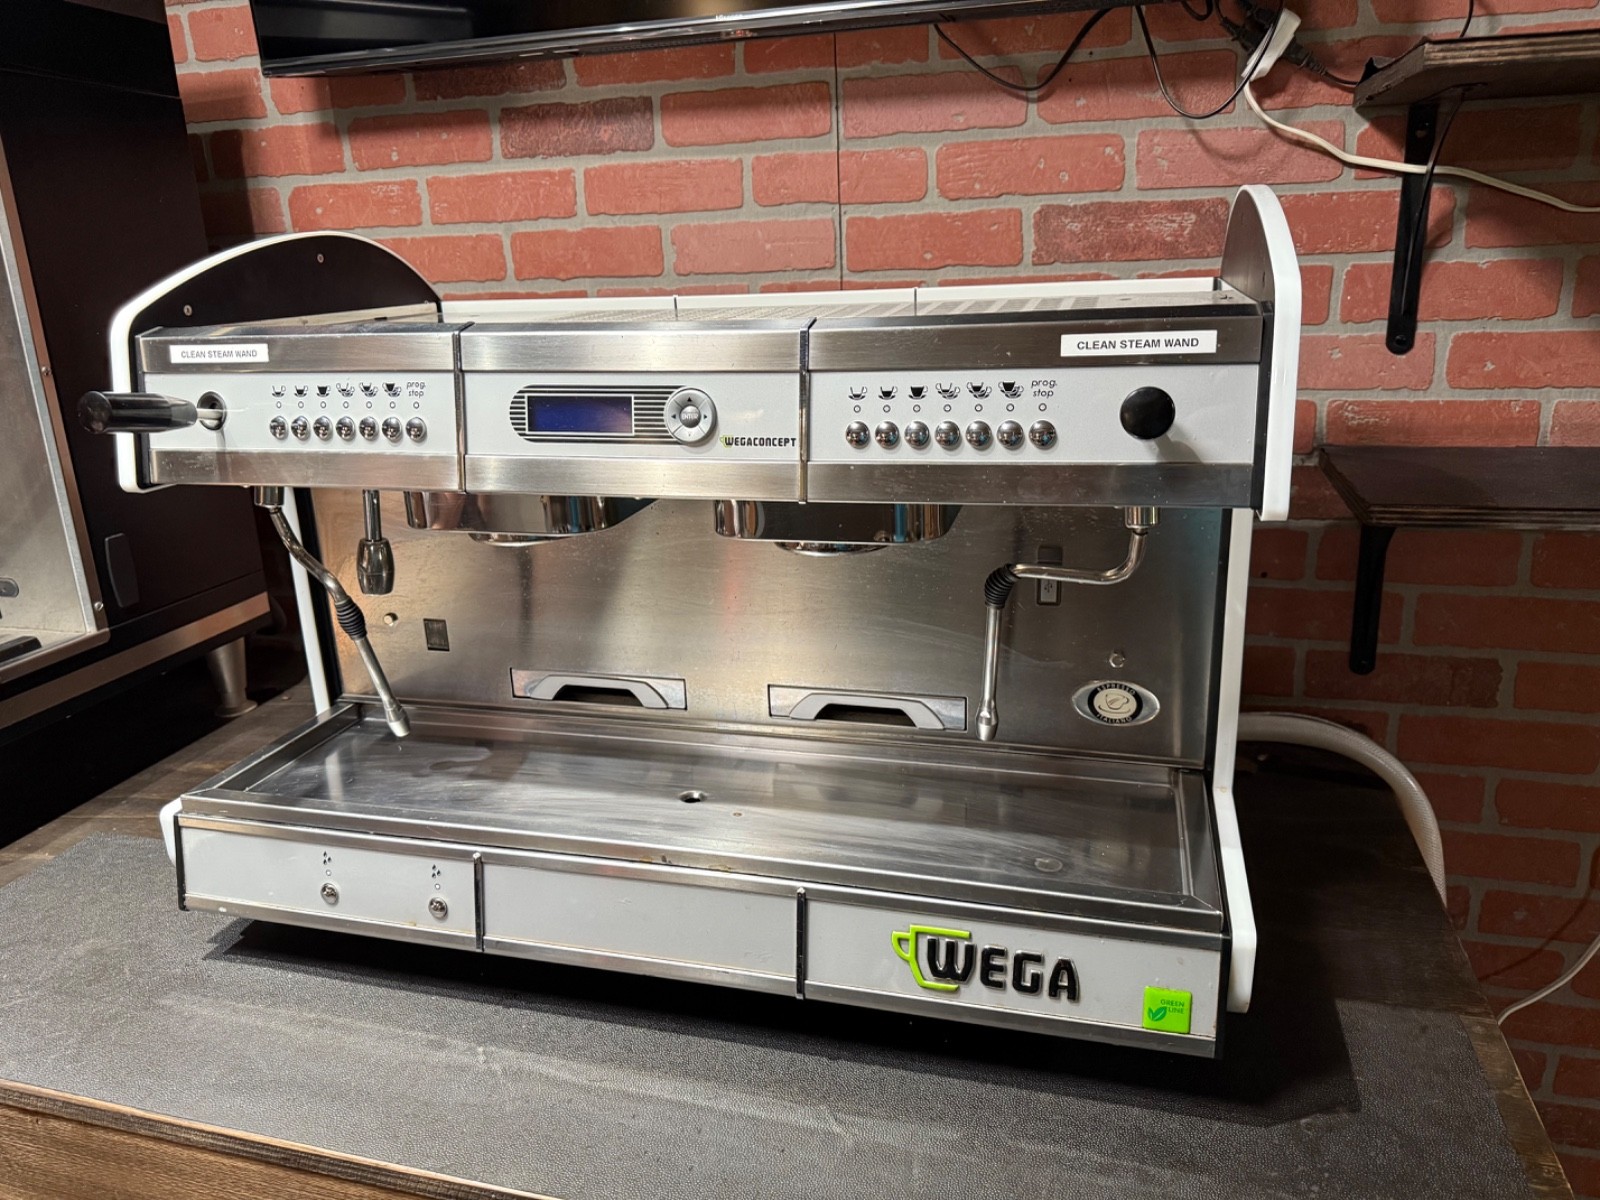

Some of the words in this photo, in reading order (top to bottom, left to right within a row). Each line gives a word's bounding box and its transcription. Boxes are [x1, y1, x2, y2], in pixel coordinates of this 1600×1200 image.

[1076, 339, 1118, 351] CLEAN
[1119, 338, 1161, 350] STEAM
[1163, 337, 1200, 349] WAND
[180, 349, 206, 359] CLEAN
[207, 349, 234, 359] STEAM
[234, 349, 258, 358] WAND
[1031, 378, 1058, 390] prog.
[408, 389, 424, 399] stop
[1032, 388, 1054, 399] stop
[724, 437, 797, 447] WEGACONCEPT
[926, 936, 1080, 1001] WEGA
[1160, 998, 1185, 1007] GREEN
[1168, 1006, 1185, 1014] LINE
